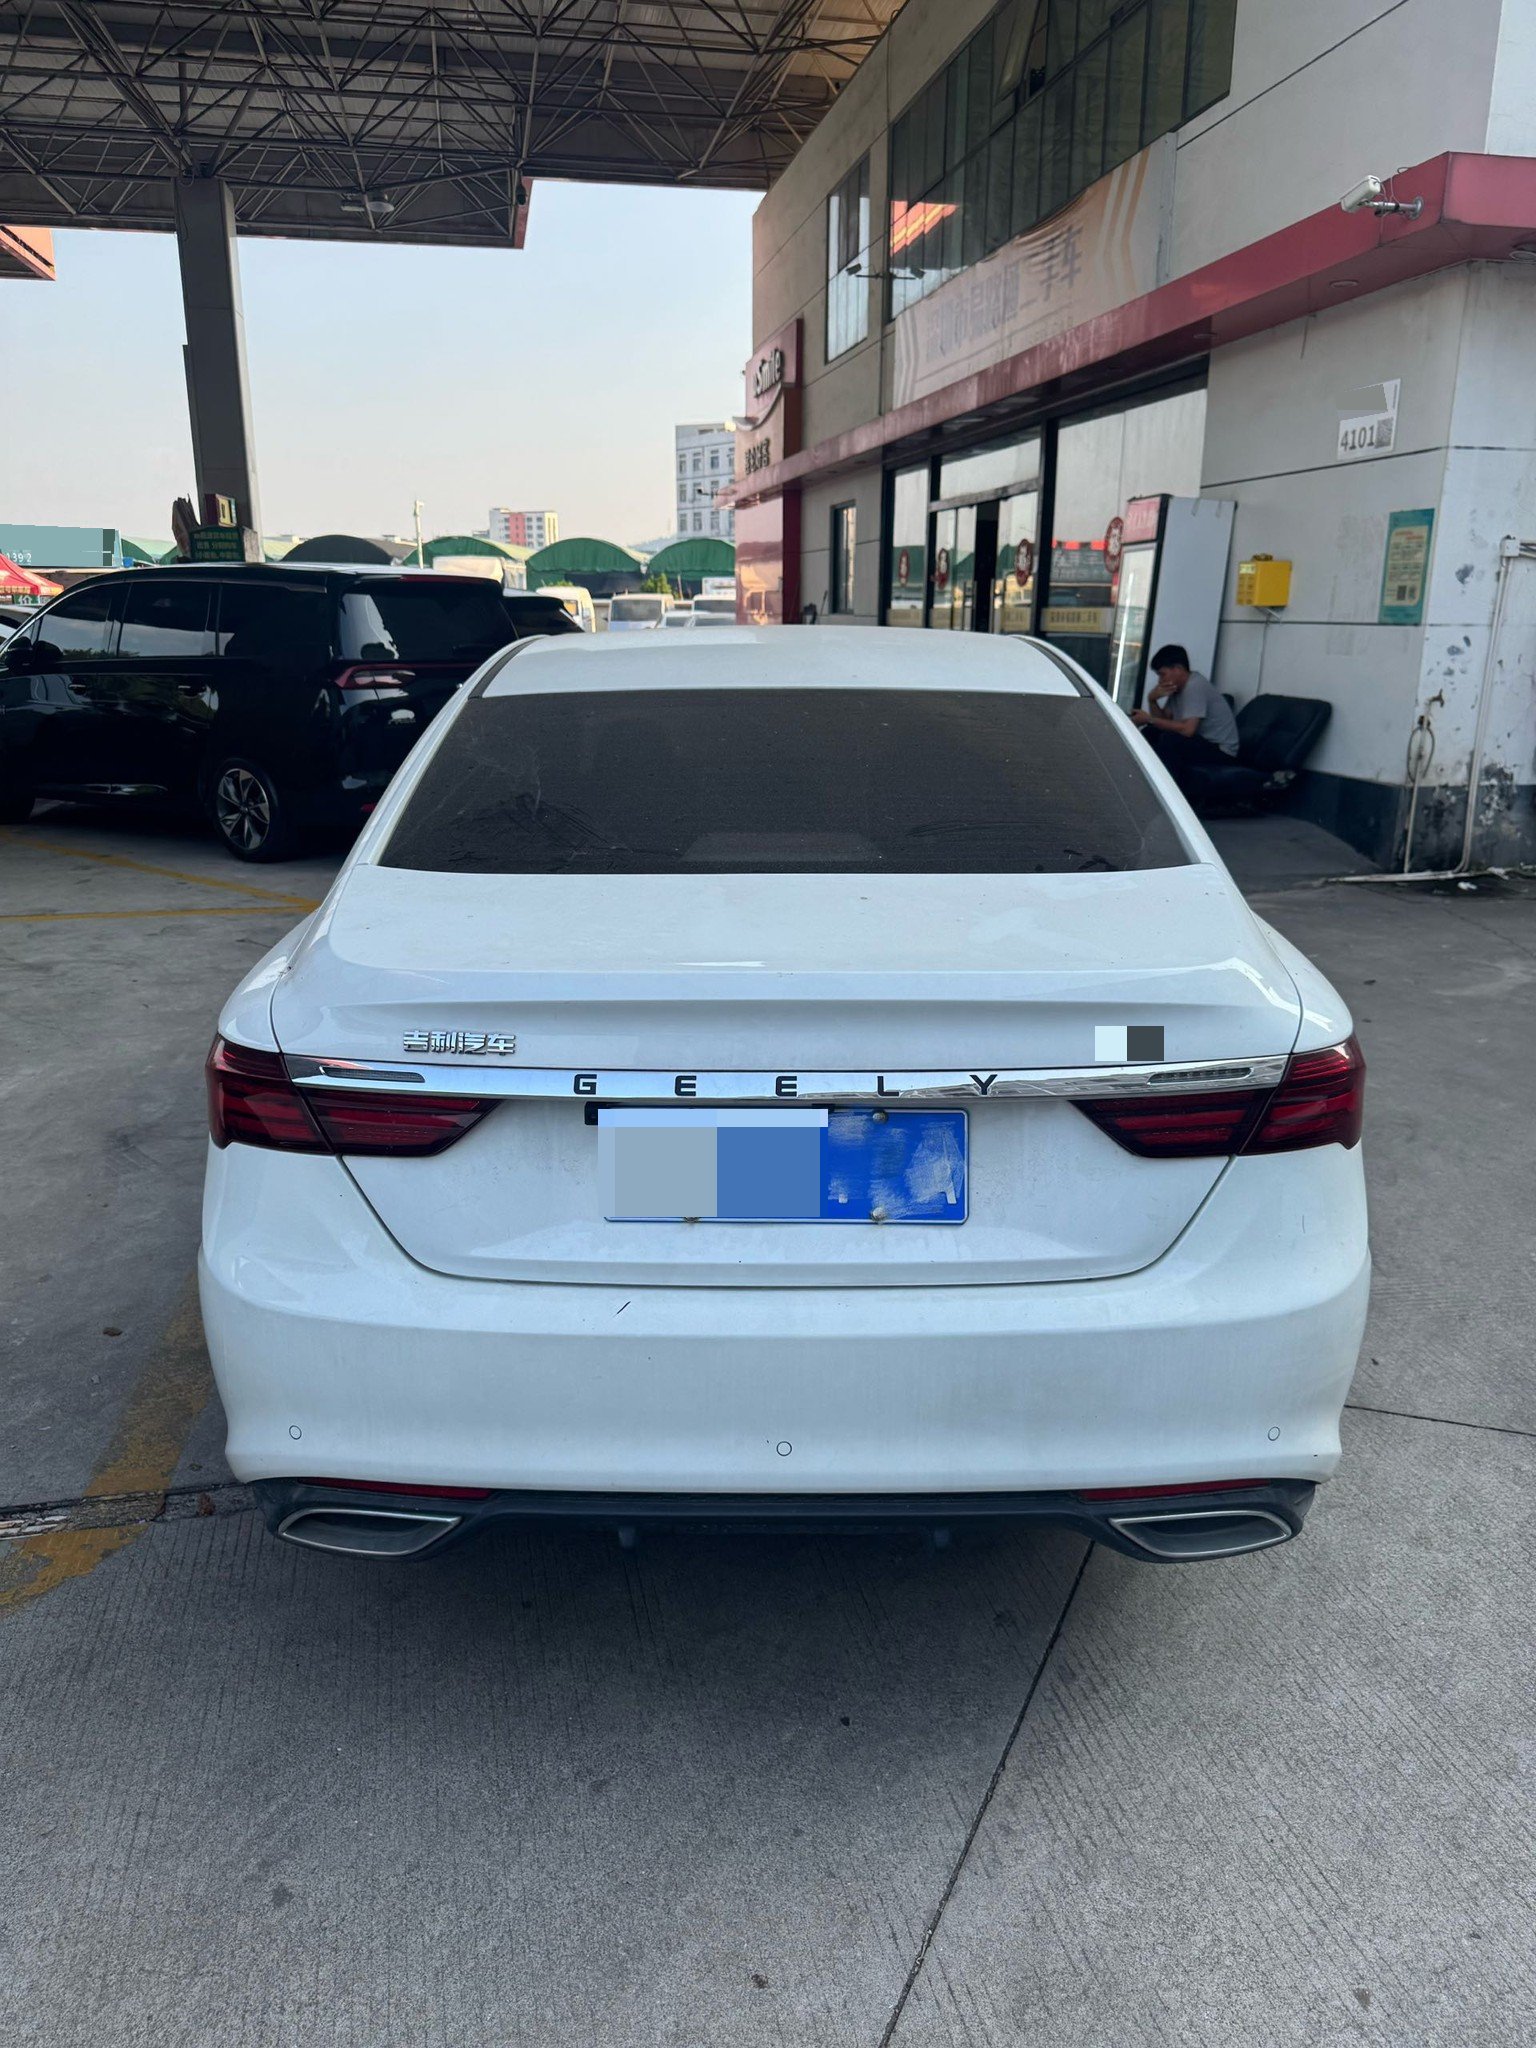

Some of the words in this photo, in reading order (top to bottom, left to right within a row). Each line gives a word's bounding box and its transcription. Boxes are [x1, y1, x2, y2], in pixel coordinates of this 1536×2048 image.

[1341, 425, 1375, 451] 4101
[403, 1030, 516, 1056] 吉利汽车
[573, 1074, 998, 1097] GEELY
